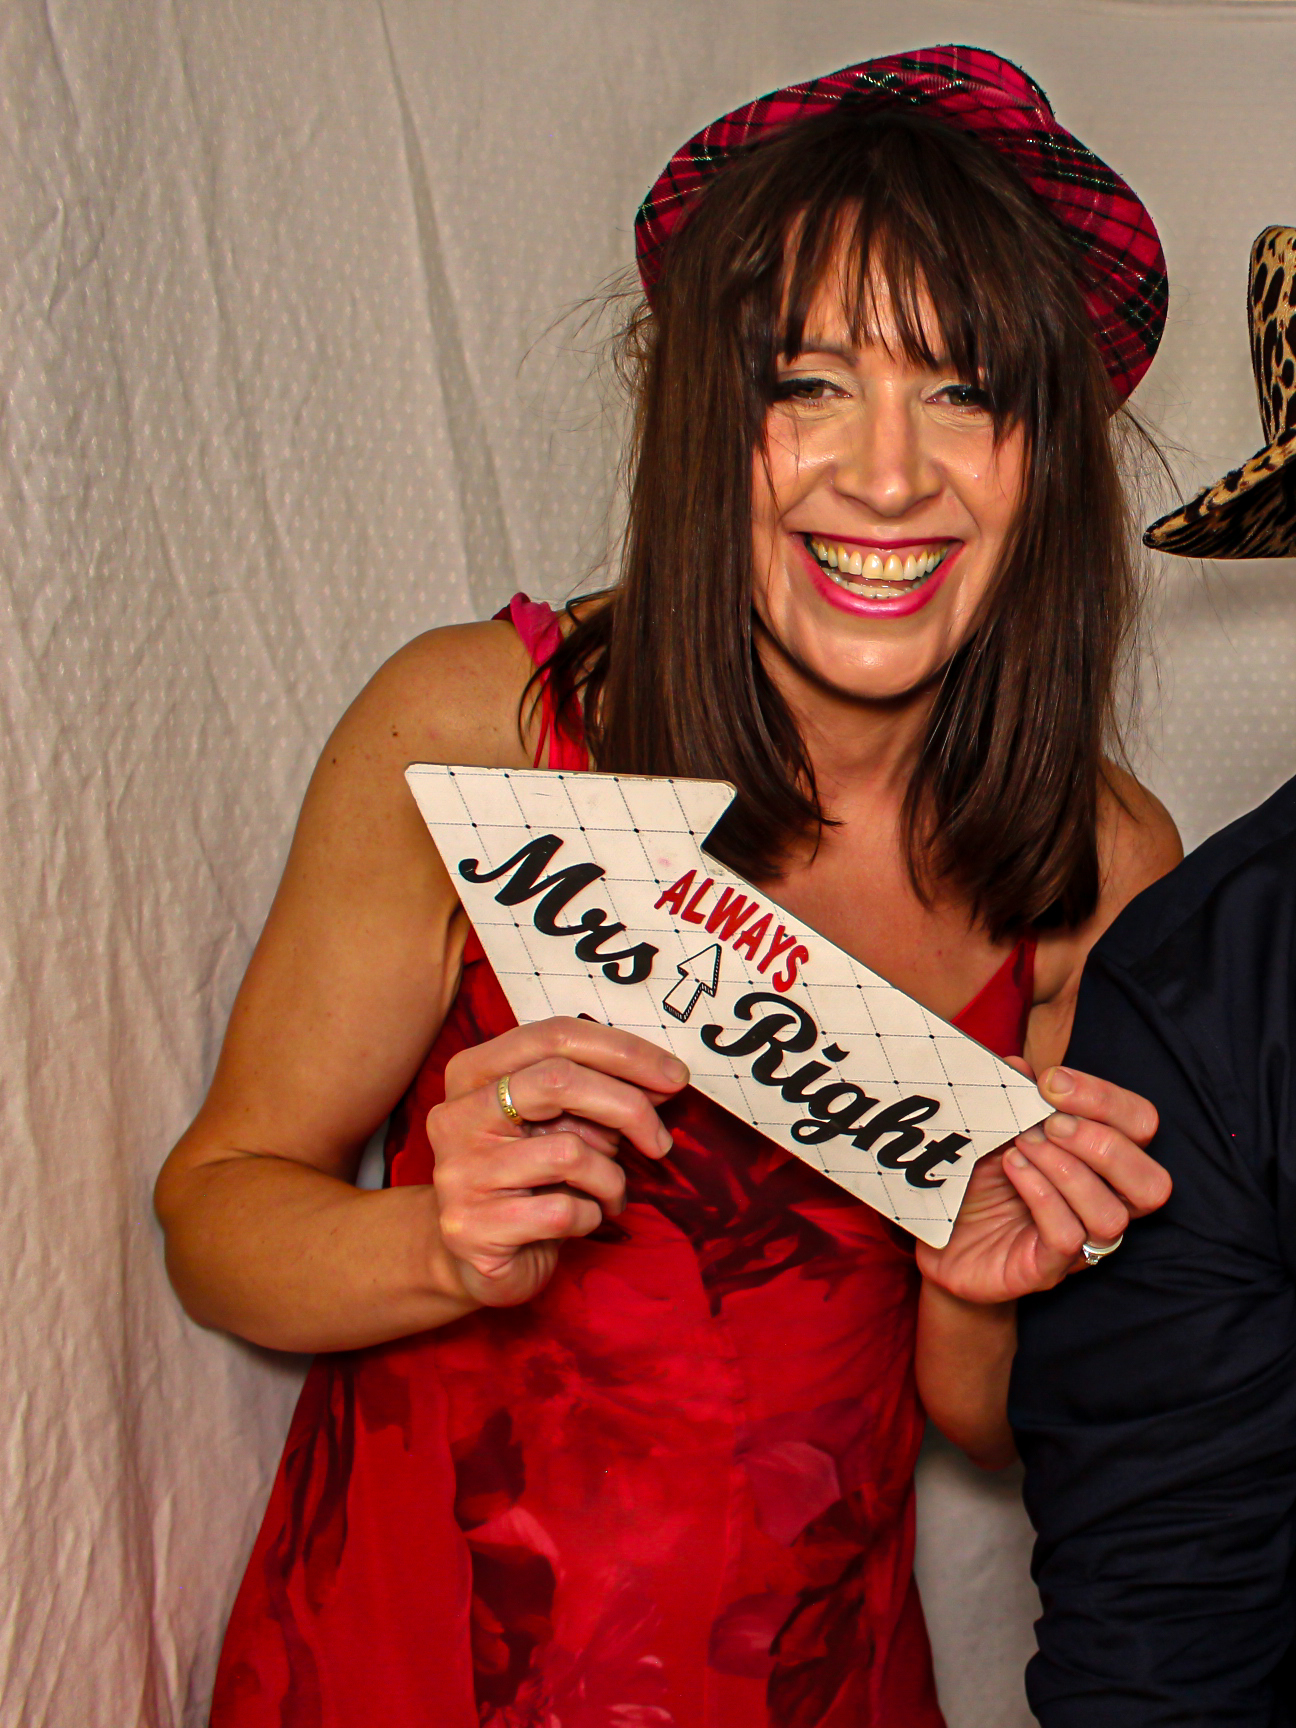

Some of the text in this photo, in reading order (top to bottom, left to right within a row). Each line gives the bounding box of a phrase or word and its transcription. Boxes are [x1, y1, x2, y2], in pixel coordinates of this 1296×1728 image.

[458, 834, 973, 1189] Mrs Right
[654, 869, 810, 993] ALWAYS
